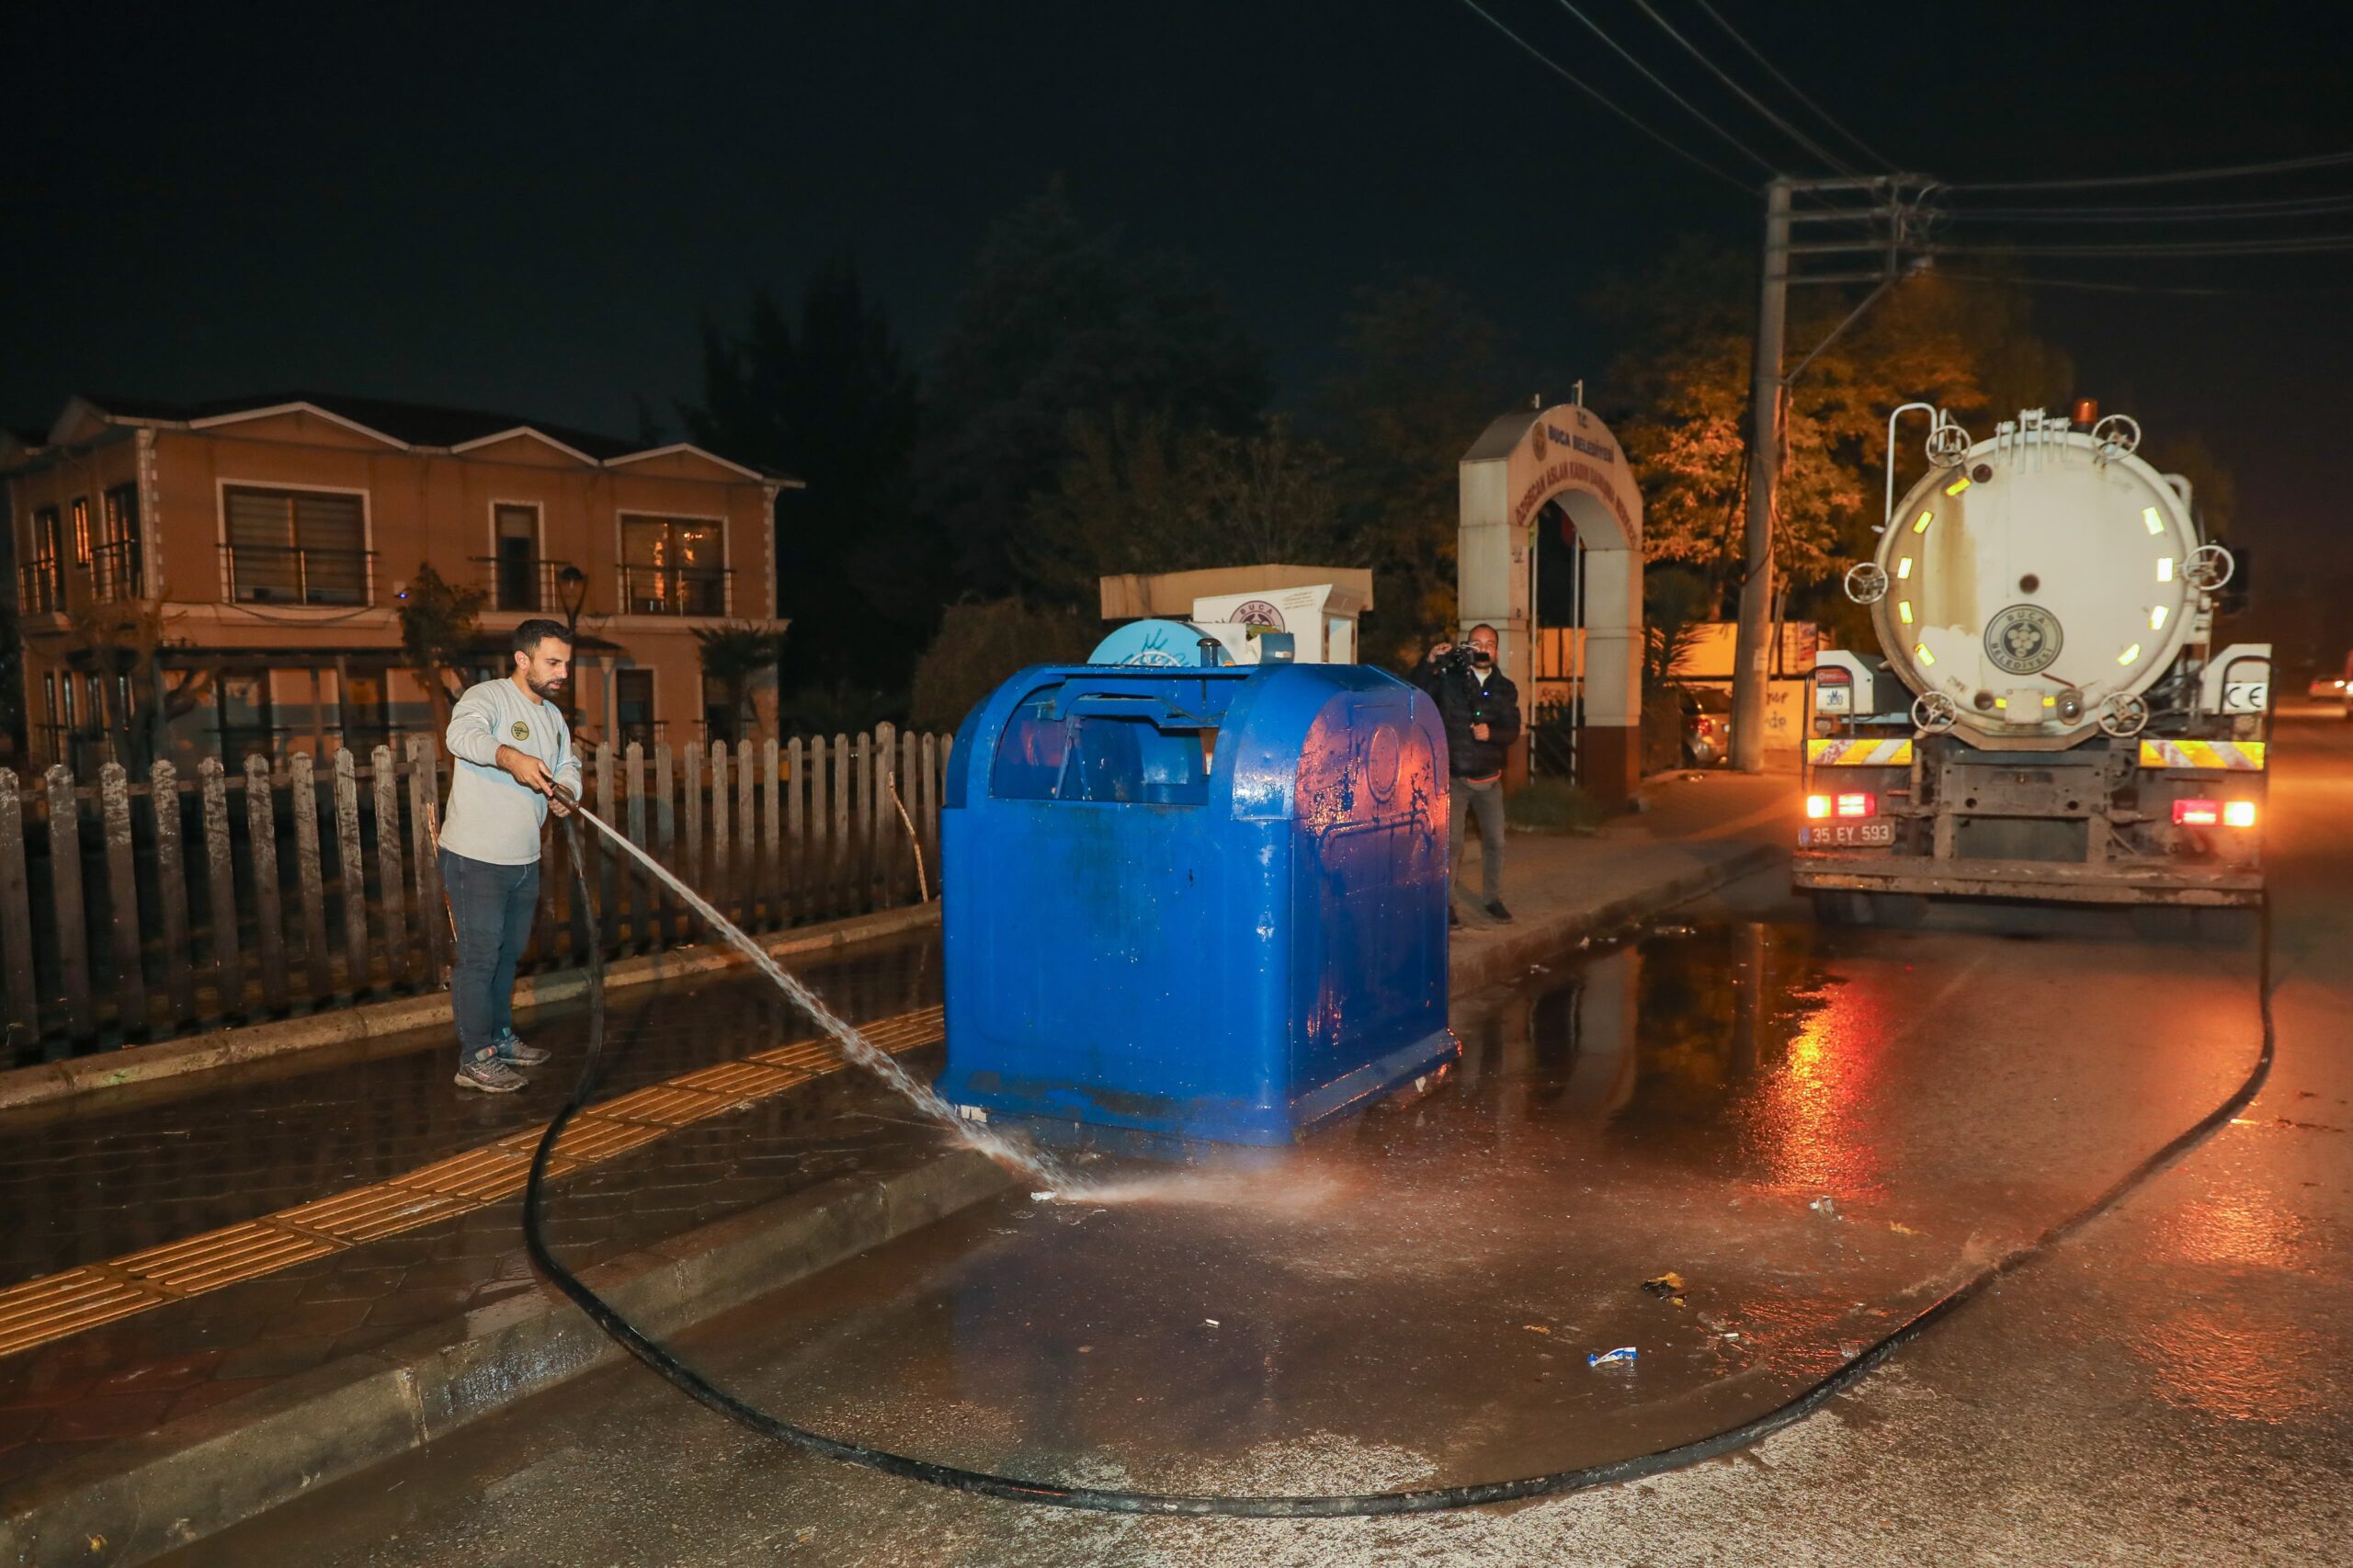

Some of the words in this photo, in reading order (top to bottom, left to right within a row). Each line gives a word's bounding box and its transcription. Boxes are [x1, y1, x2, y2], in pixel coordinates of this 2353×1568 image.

[1548, 424, 1571, 448] BUCA
[1239, 604, 1273, 615] BUCA
[2006, 611, 2045, 624] BUCA
[2227, 686, 2263, 708] CE
[1813, 828, 1830, 843] 35
[1836, 826, 1854, 842] EY
[1861, 824, 1889, 841] 593
